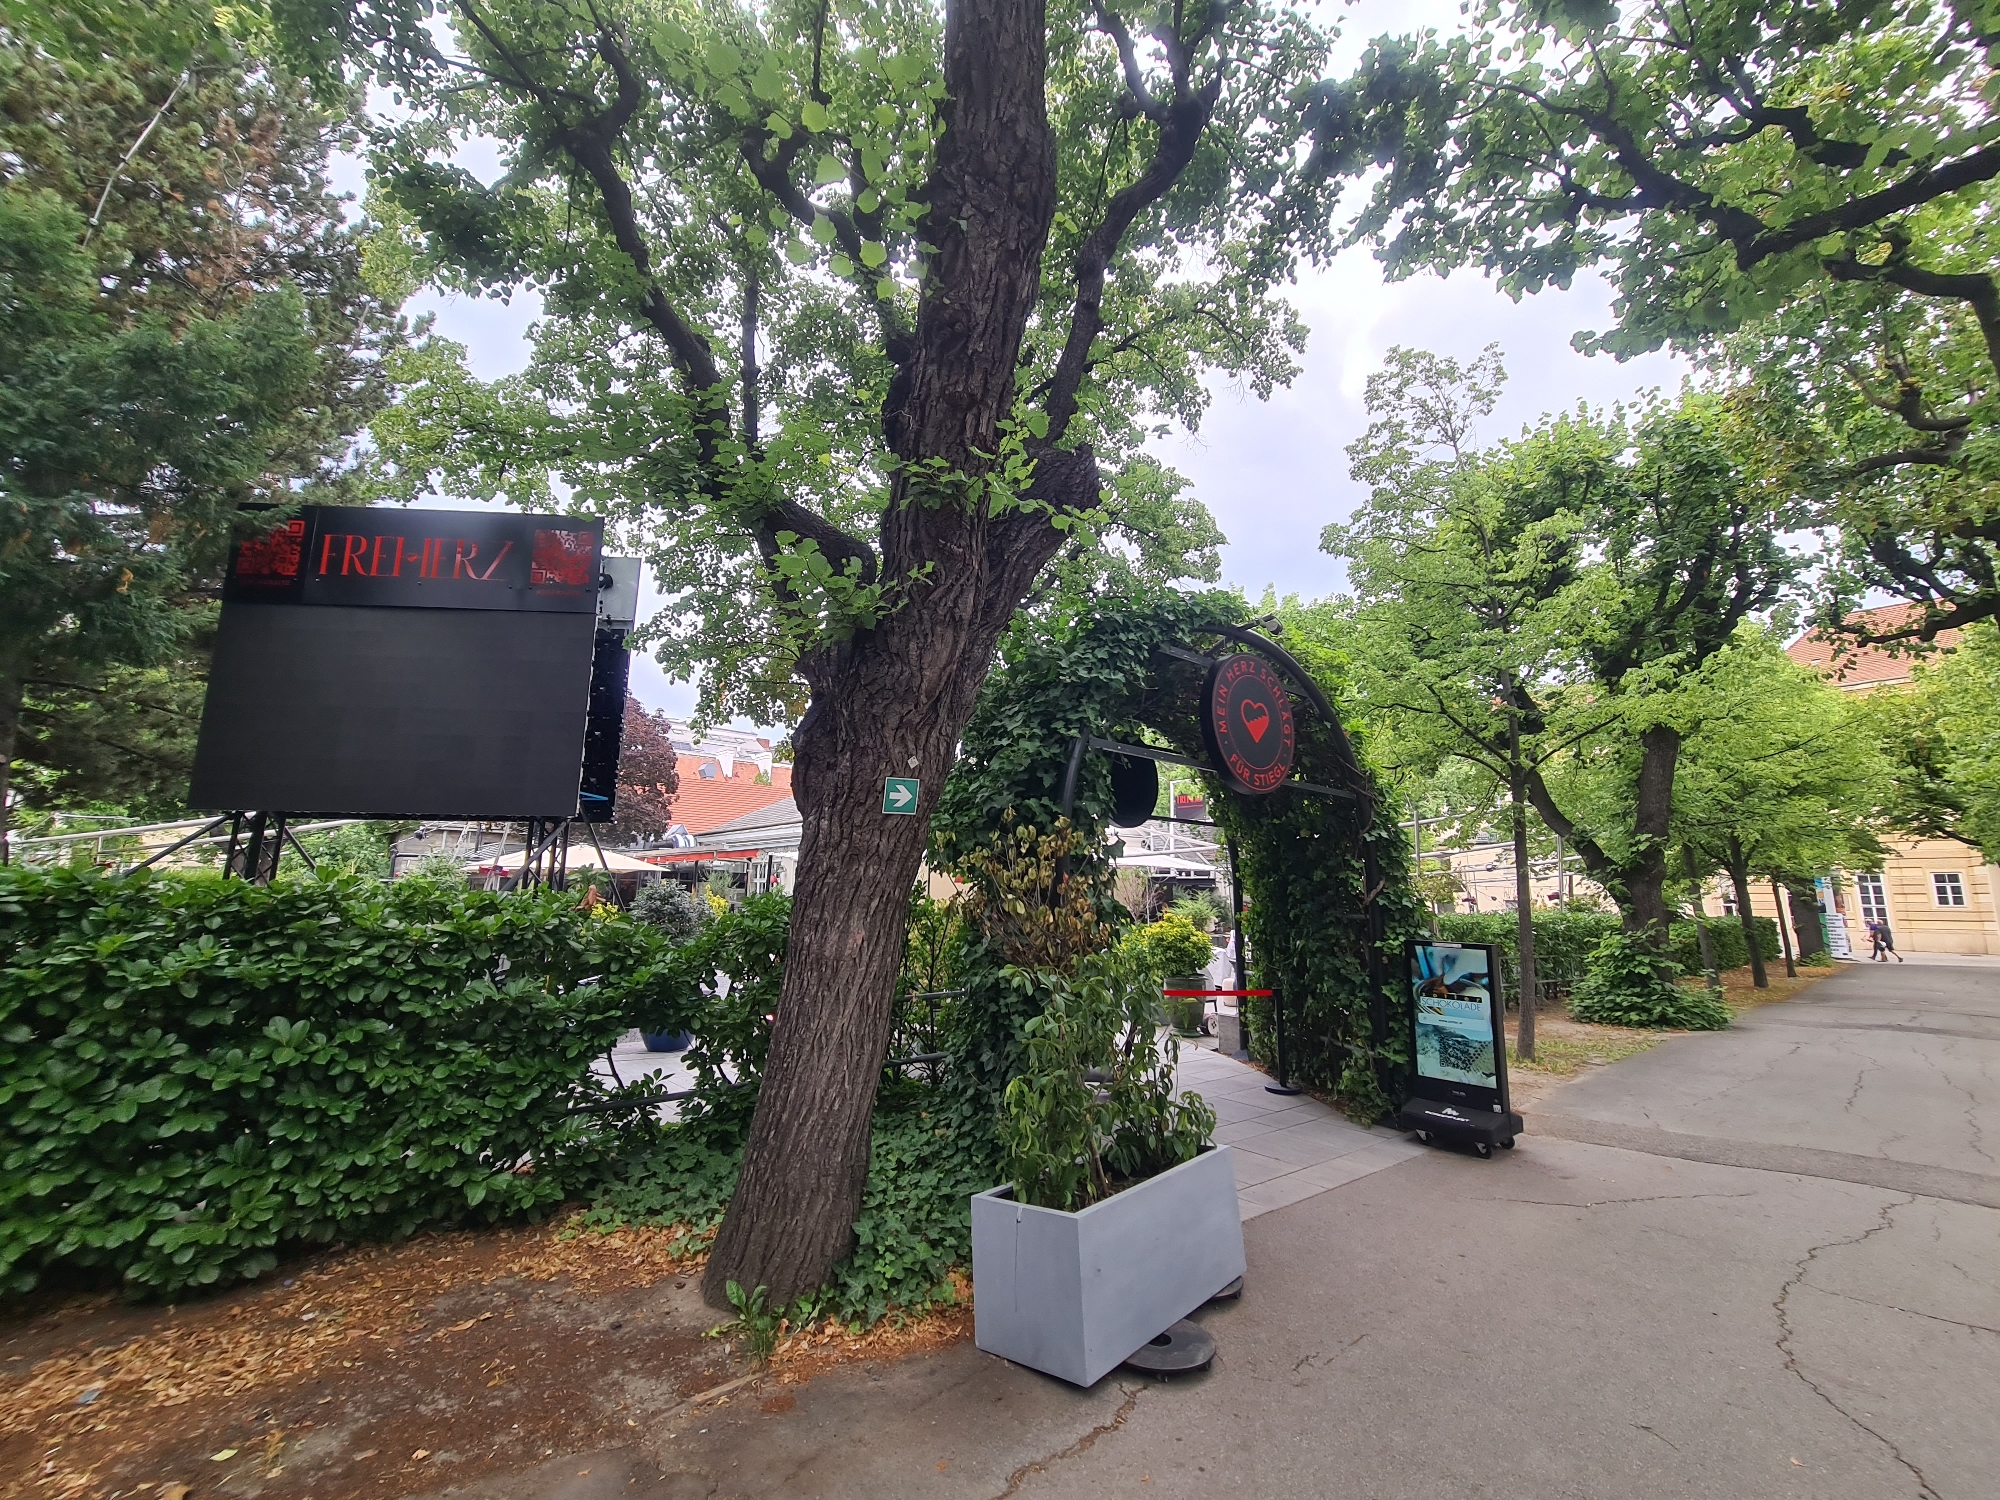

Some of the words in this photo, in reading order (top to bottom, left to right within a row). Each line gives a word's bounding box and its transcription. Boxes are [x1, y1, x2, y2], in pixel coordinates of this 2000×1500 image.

[1217, 684, 1228, 733] MEIN
[1226, 661, 1255, 681] HERZ
[1260, 668, 1290, 747] SCHLÄGT
[1230, 753, 1251, 780] FÜR
[1253, 762, 1286, 786] STIEGL
[1421, 998, 1481, 1012] SCHOKOLADE
